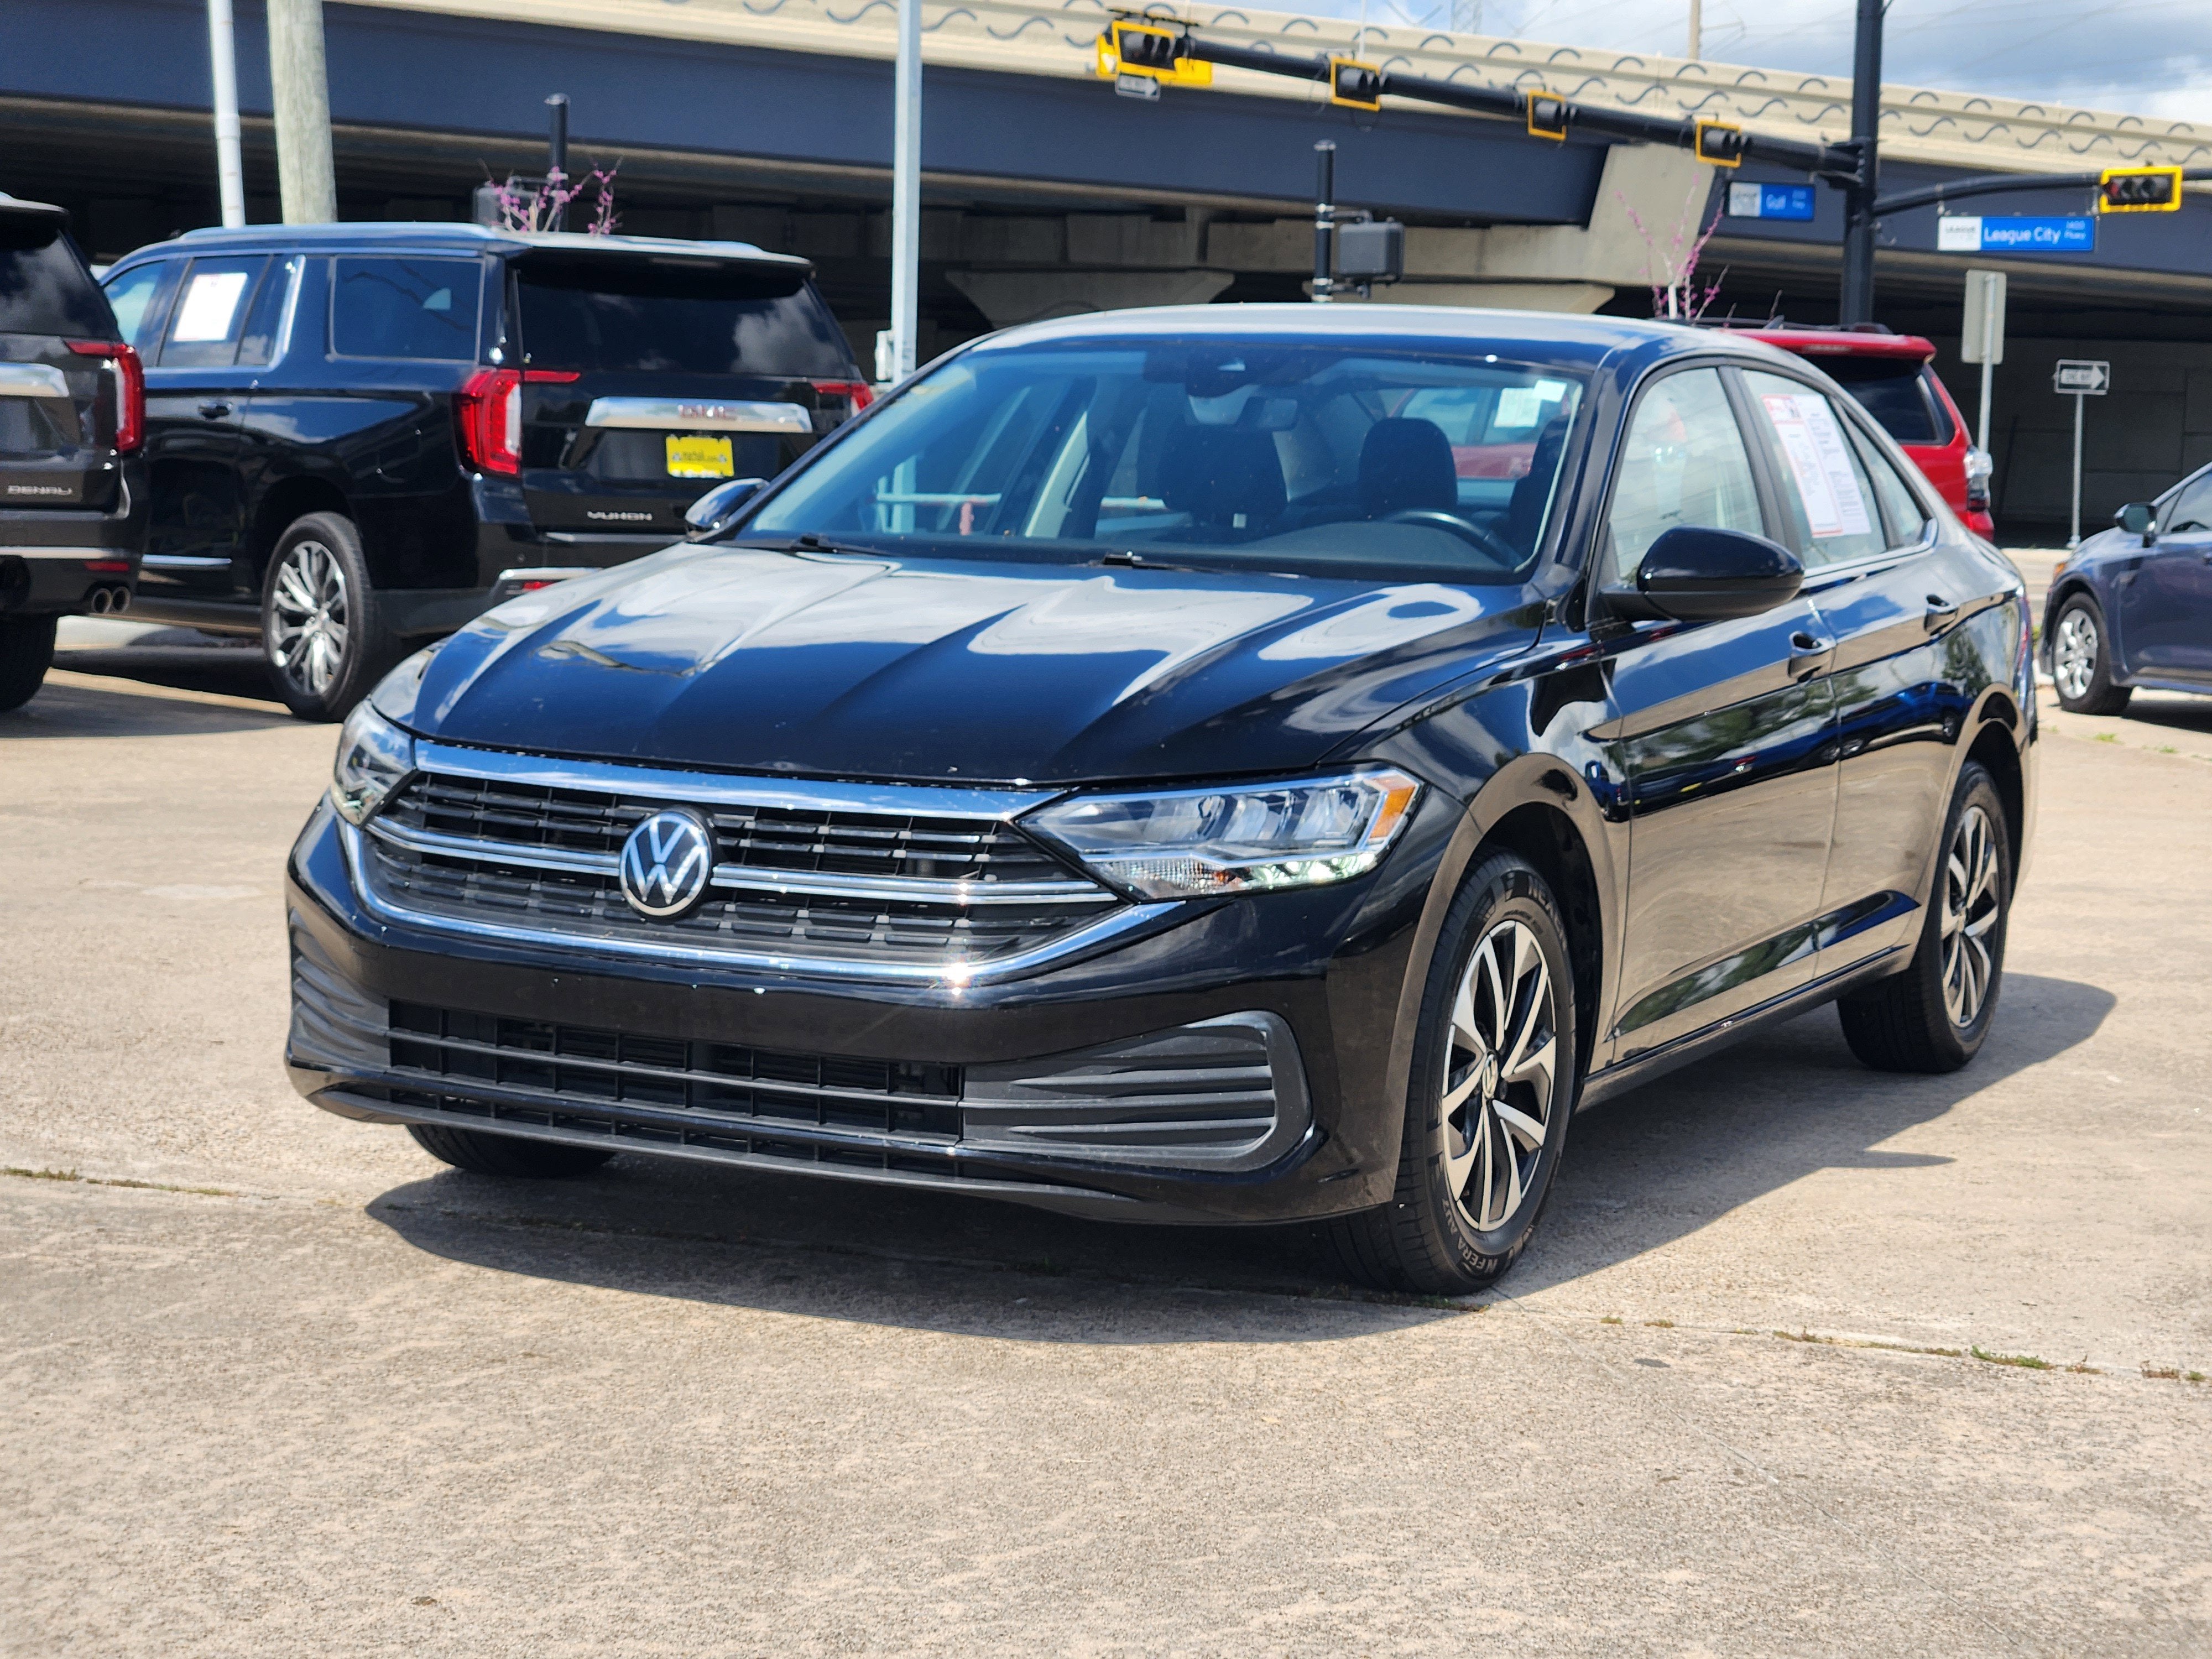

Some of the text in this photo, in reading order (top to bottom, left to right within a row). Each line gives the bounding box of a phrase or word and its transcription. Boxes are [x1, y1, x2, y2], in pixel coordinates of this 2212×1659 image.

[1984, 226, 2061, 245] League City
[8, 485, 72, 495] DENALI
[587, 511, 653, 520] YUKON
